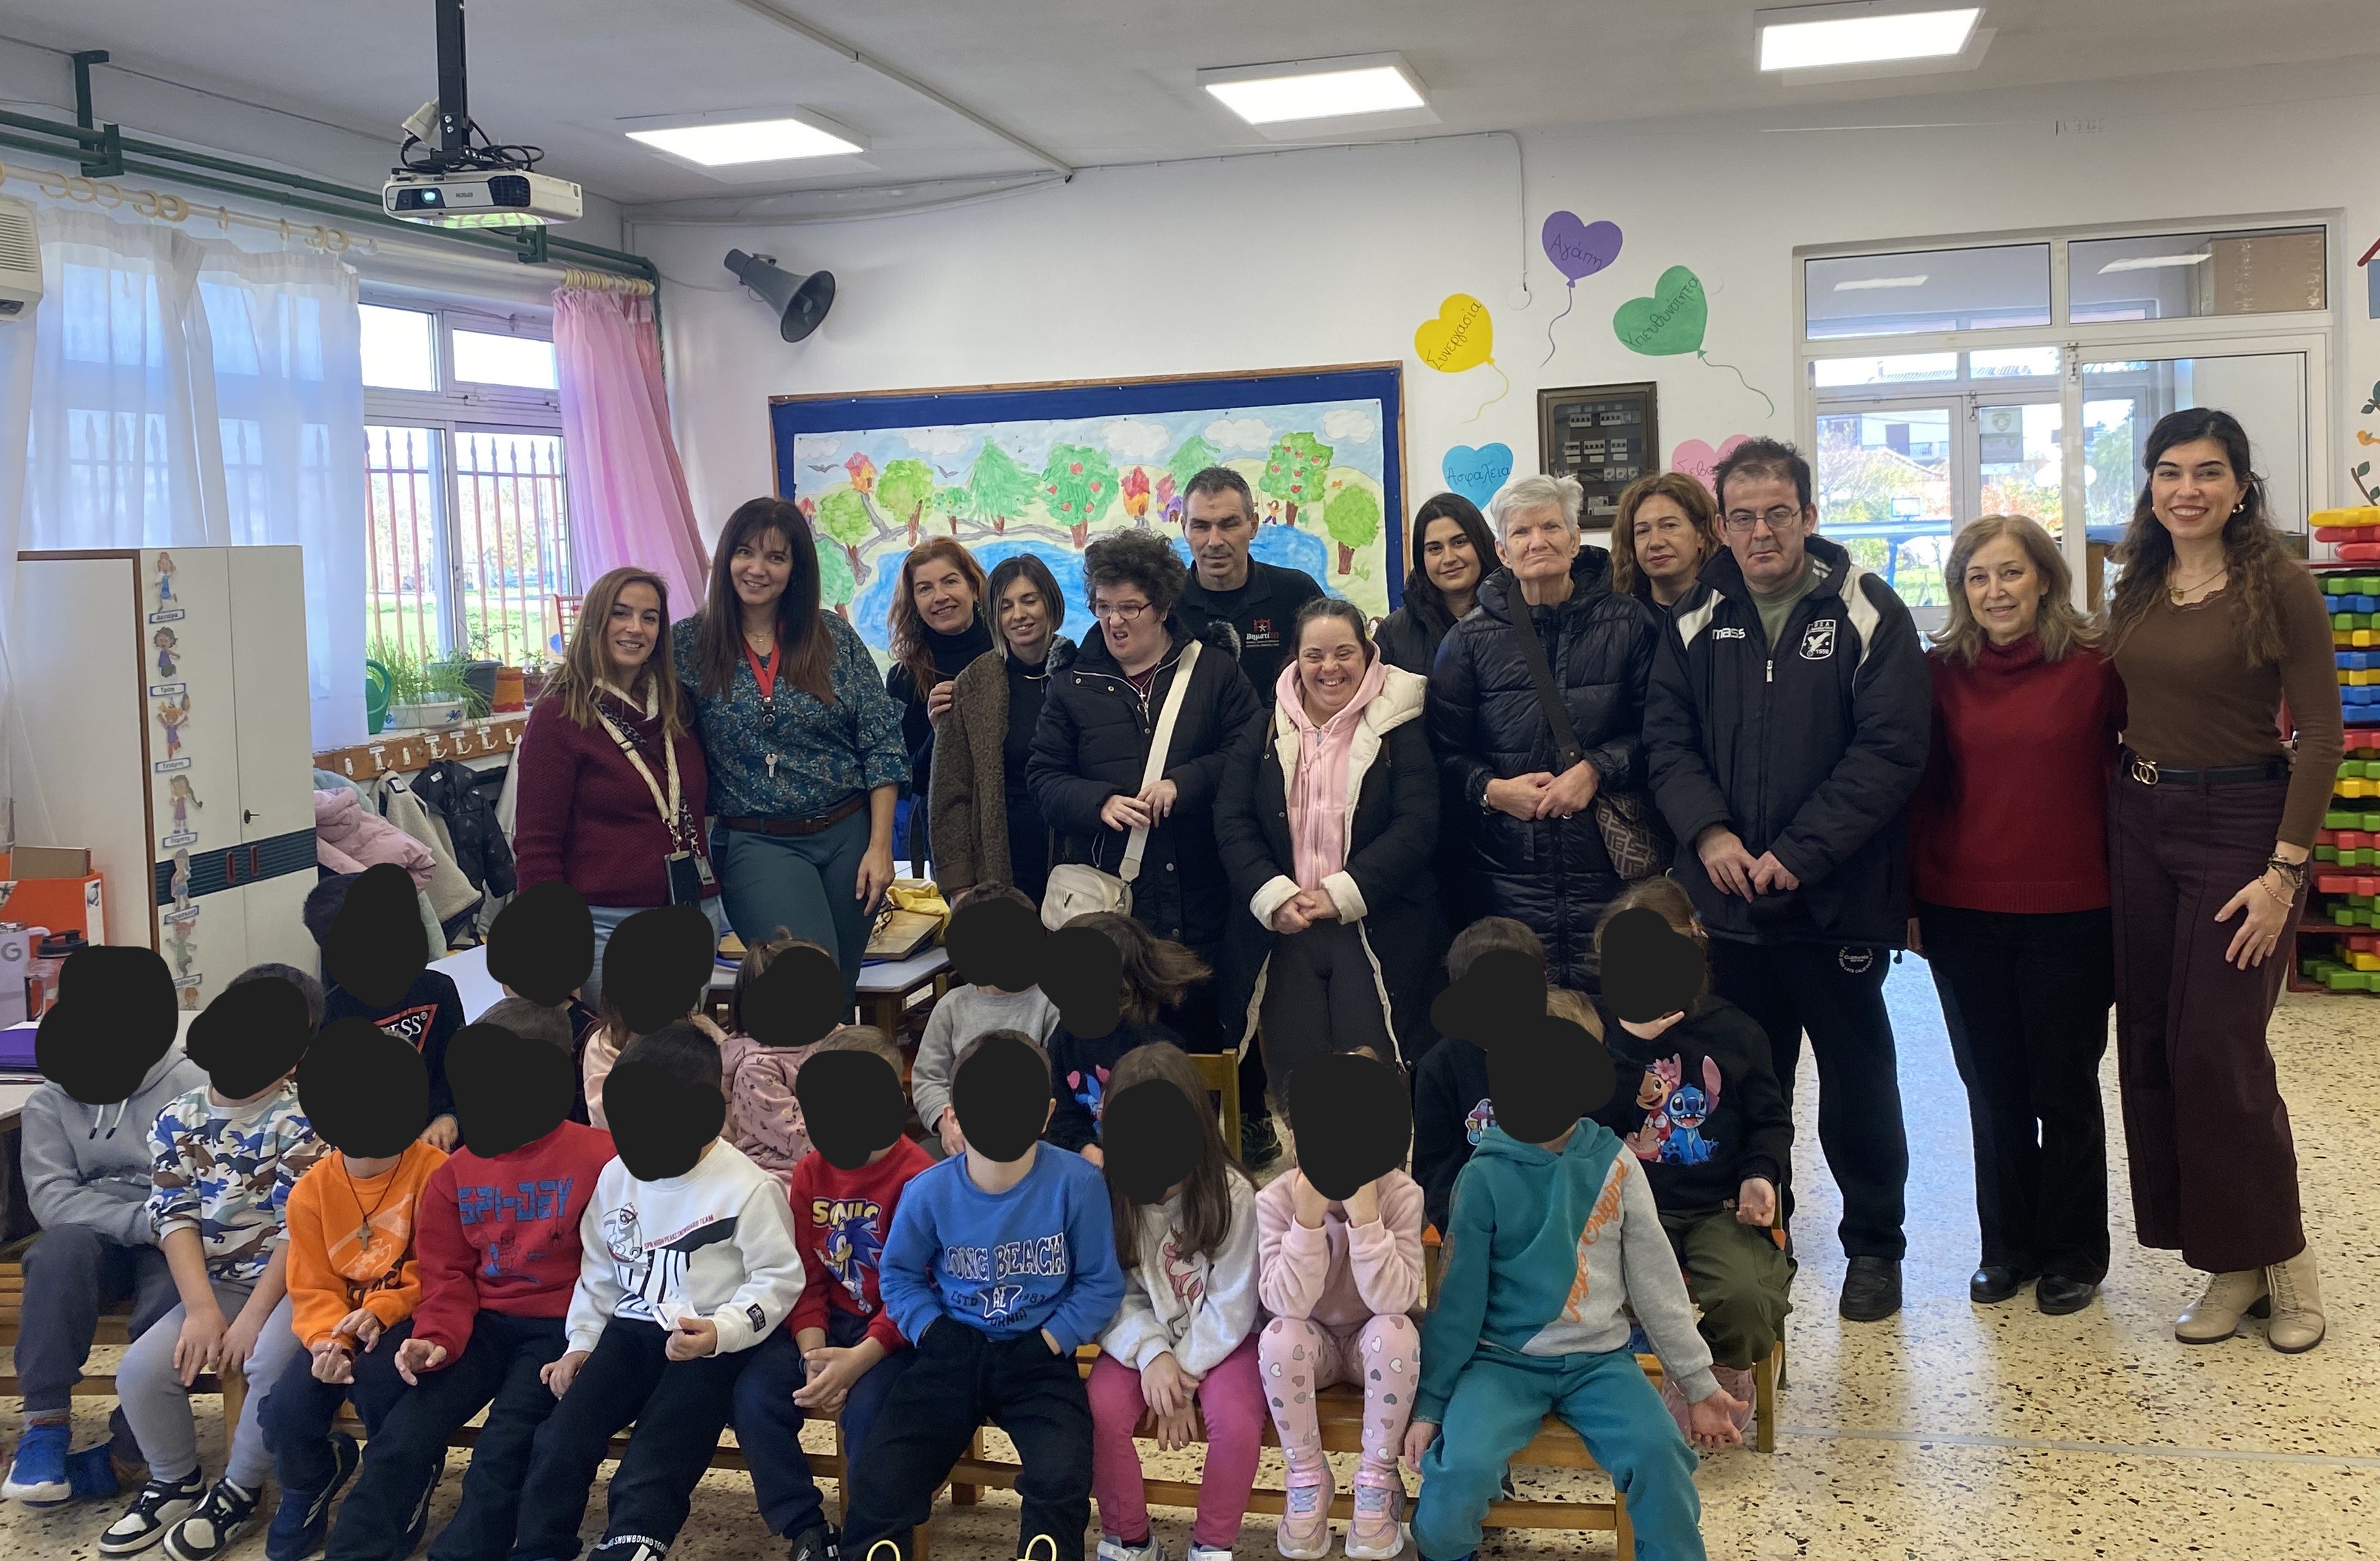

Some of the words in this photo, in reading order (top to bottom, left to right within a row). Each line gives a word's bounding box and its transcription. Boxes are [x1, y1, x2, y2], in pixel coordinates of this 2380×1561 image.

[1549, 233, 1602, 272] Αγάπη
[1621, 277, 1699, 348] Υπευθυνότητα
[1426, 302, 1482, 370] Συνεργασία
[1712, 627, 1746, 640] mass
[1, 942, 23, 962] G
[458, 1178, 573, 1226] SPI-DEY
[699, 1214, 715, 1226] TEAM
[946, 1246, 990, 1281] ONG
[993, 1232, 1066, 1281] BEACH
[614, 1534, 654, 1547] SNOWBOARD
